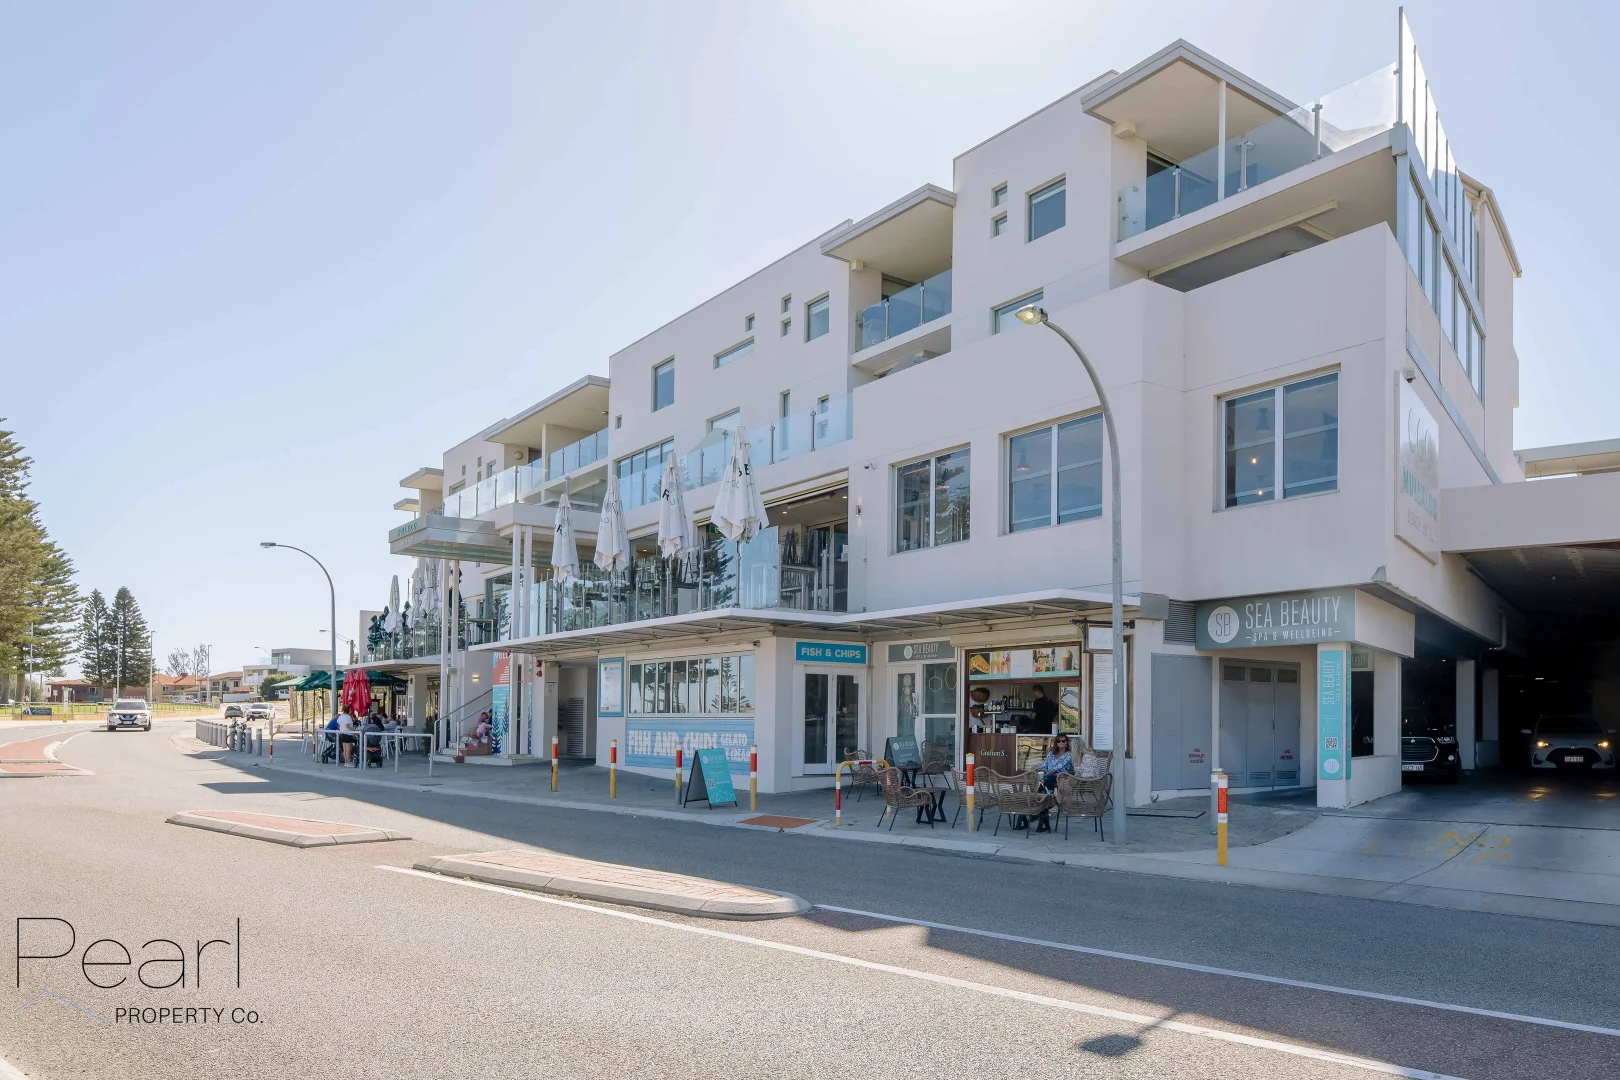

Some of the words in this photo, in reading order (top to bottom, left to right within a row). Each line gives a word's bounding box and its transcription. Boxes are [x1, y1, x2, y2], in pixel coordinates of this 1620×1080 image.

[1245, 602, 1273, 629] SEA
[1280, 595, 1341, 627] BEAUTY
[1215, 612, 1231, 637] SB
[1253, 632, 1268, 642] SPA
[1282, 627, 1333, 640] WELLBEING
[801, 647, 822, 657] FISH
[825, 648, 832, 657] &
[835, 649, 861, 659] CHIPS
[1322, 660, 1335, 688] BEAUTY
[1322, 690, 1335, 705] SEA
[628, 729, 652, 756] FISH
[653, 731, 680, 757] AND
[720, 732, 748, 746] GELATO
